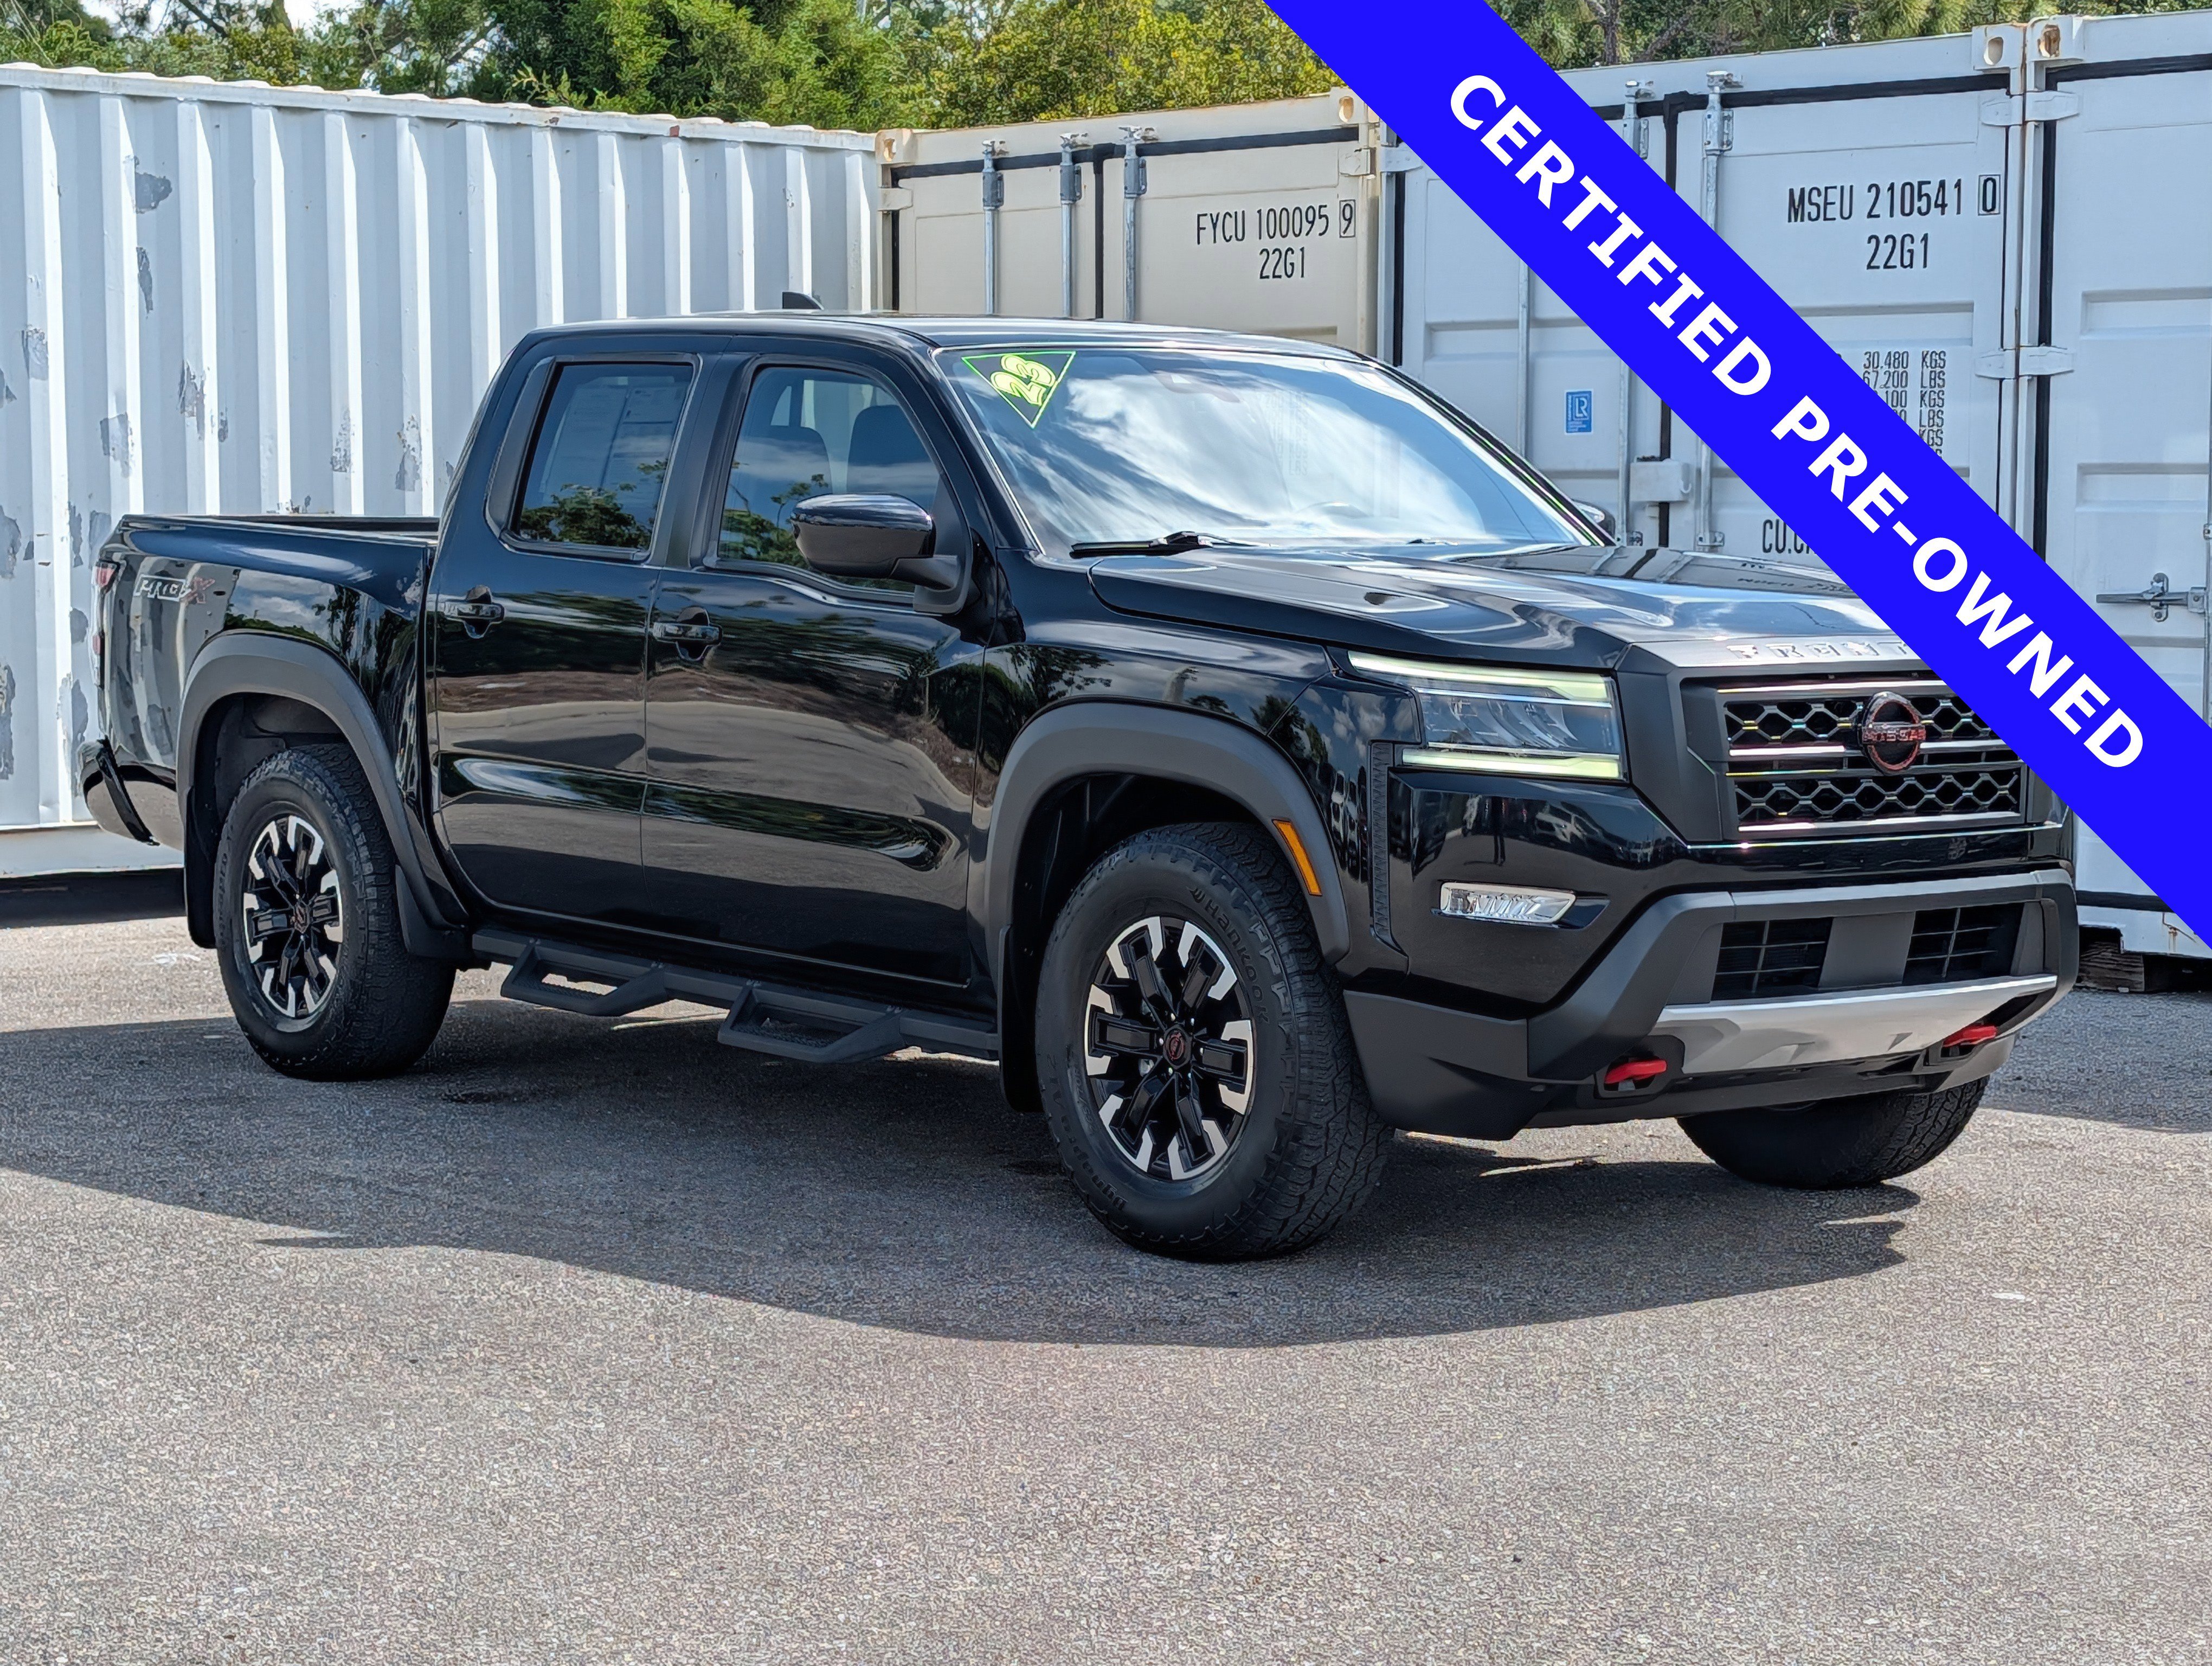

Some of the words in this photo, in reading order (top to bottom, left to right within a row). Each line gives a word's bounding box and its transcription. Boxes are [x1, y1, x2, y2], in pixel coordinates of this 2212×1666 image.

[1787, 184, 1854, 223] MSEU
[1867, 178, 1962, 218] 210541
[1982, 176, 1998, 212] 0
[1196, 210, 1245, 245] FYCU
[1257, 204, 1329, 240] 100095
[1342, 202, 1353, 235] 9
[1259, 246, 1305, 279] 22G1
[1866, 233, 1930, 270] 22G1
[1863, 350, 1909, 369] 30.480
[1921, 350, 1946, 369] KGS
[991, 354, 1056, 406] 23
[1920, 370, 1946, 389] LBS
[1920, 389, 1945, 408] KGS
[1919, 408, 1944, 428] LBS
